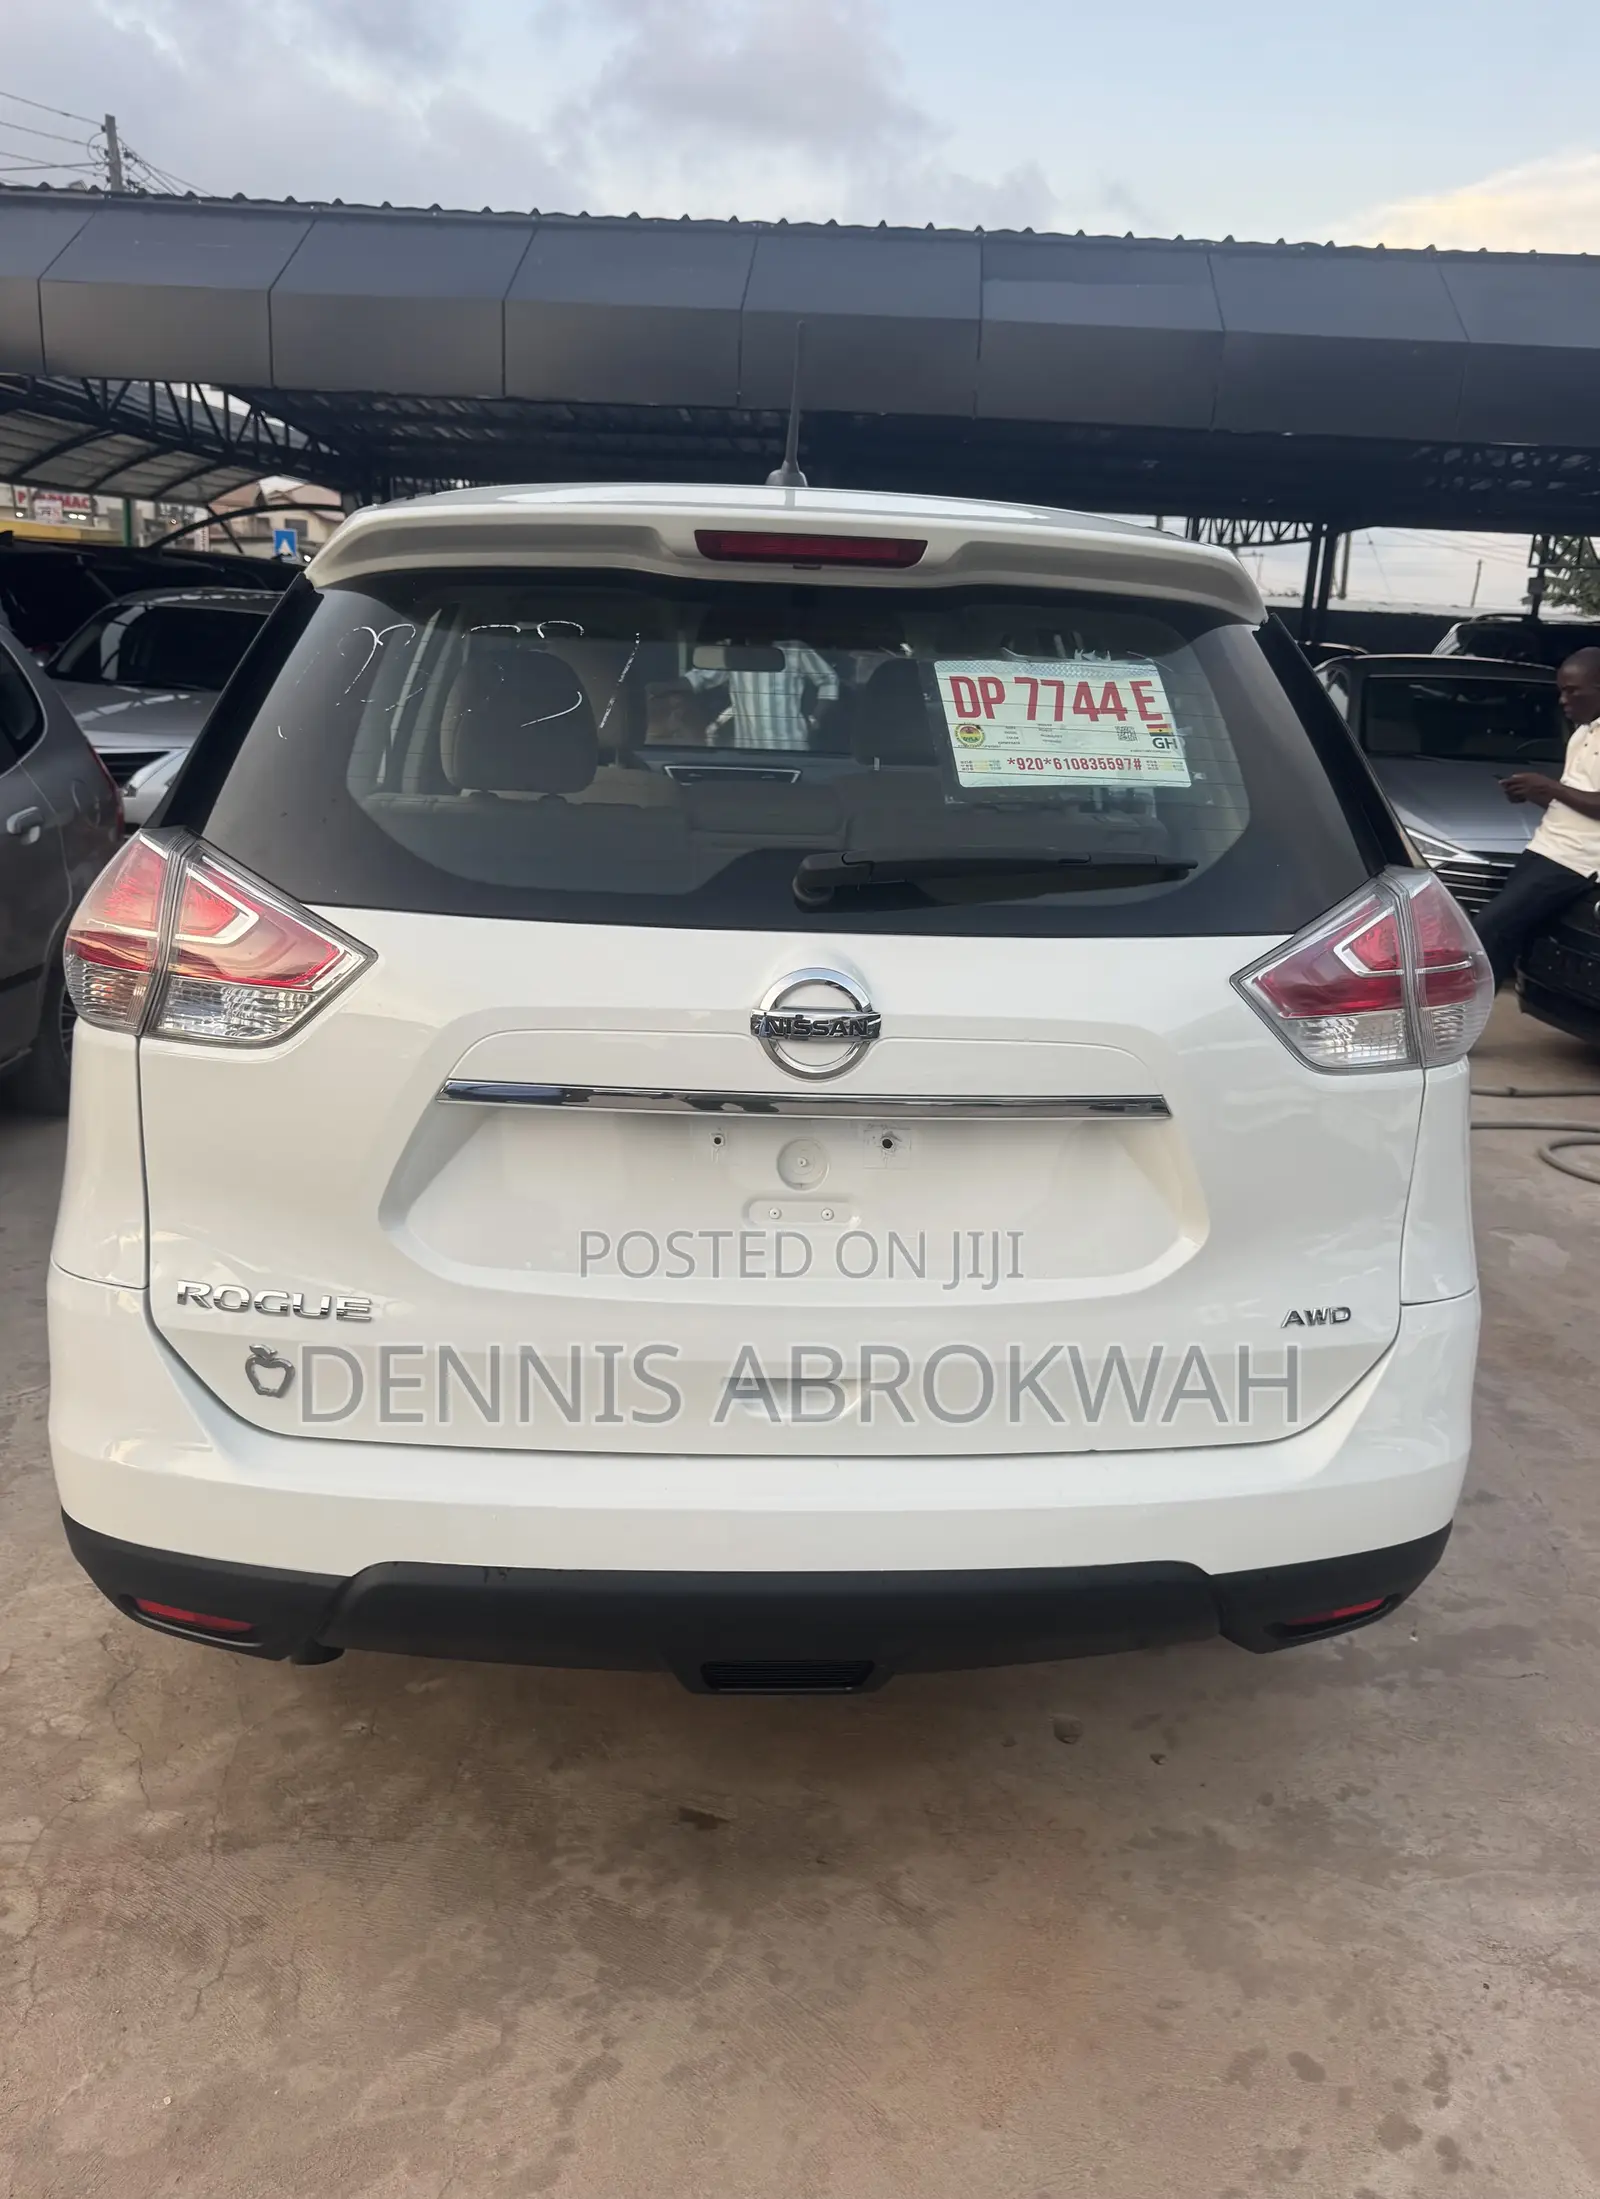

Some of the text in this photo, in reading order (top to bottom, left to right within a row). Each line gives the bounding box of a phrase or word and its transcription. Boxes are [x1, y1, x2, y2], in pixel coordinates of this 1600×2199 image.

[950, 676, 1163, 721] DP 7744 E
[1152, 737, 1179, 749] GH
[764, 1018, 868, 1037] NISSAN
[176, 1279, 372, 1323] ROGUE
[1280, 1306, 1351, 1328] AWD
